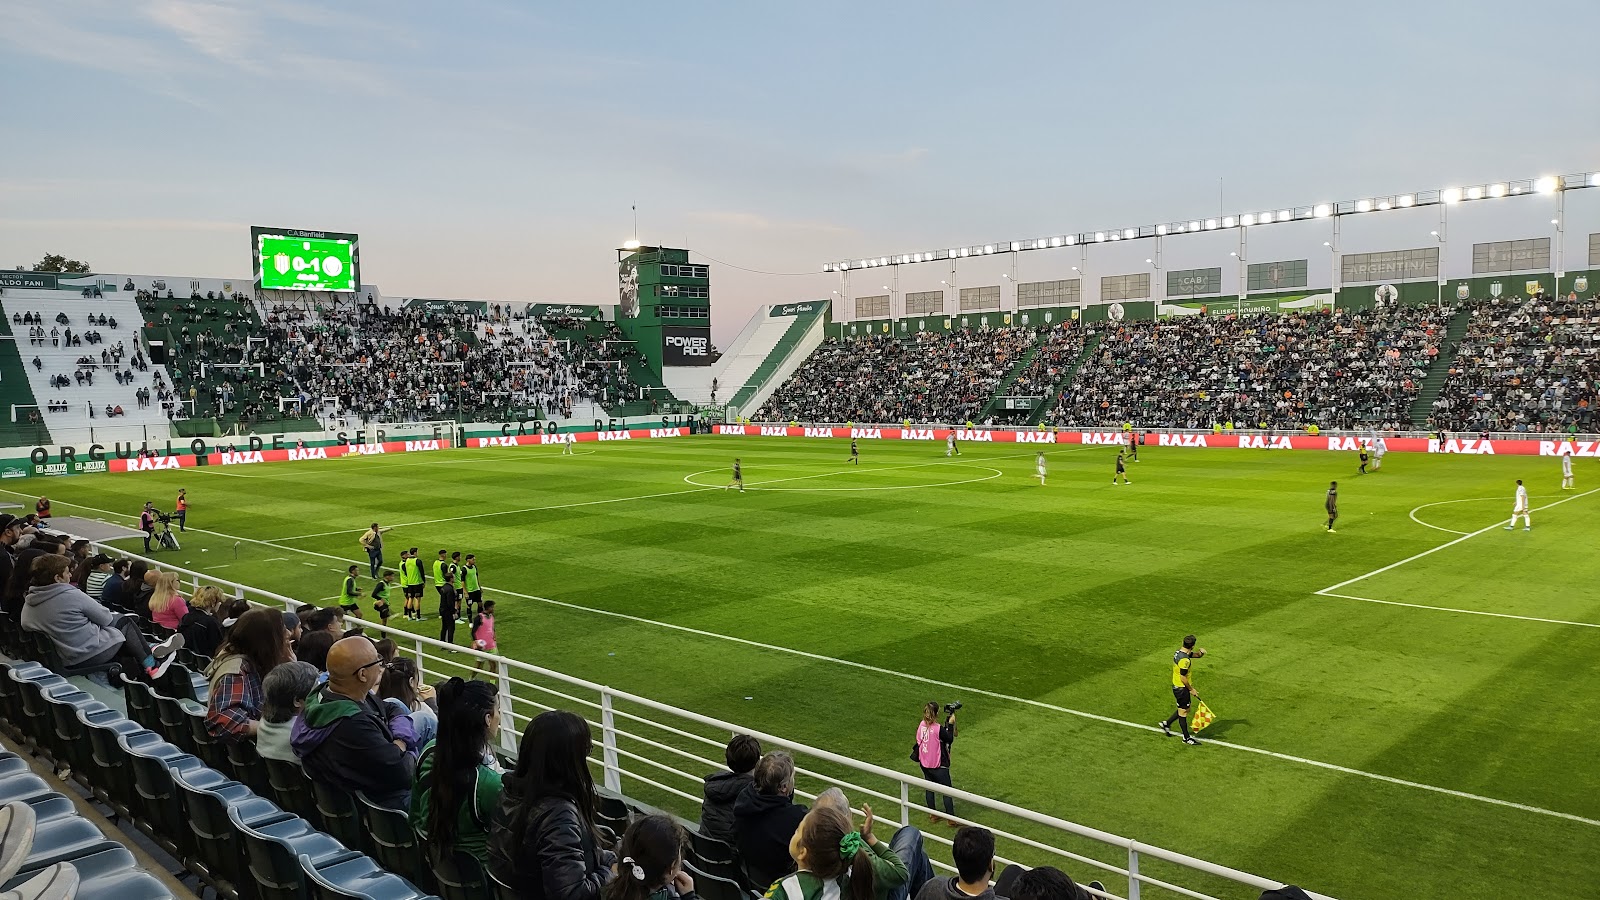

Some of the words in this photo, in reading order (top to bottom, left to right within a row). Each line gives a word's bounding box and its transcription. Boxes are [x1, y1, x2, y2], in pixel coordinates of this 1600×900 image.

[287, 230, 325, 239] C.A.Banfield
[292, 256, 320, 272] 0-1
[1183, 276, 1202, 284] CAB
[665, 336, 707, 347] POWER
[683, 346, 709, 356] ADE
[249, 434, 285, 452] DE
[337, 429, 386, 446] SER
[595, 418, 630, 432] DEL
[662, 415, 694, 428] SUR
[598, 430, 632, 441] RAZA
[650, 428, 681, 438] RAZA
[720, 425, 746, 435] RAZA
[761, 426, 788, 436] RAZA
[805, 428, 833, 438] RAZA
[850, 428, 882, 439] RAZA
[901, 429, 935, 440] RAZA
[957, 430, 992, 441] RAZA
[479, 436, 519, 448] RAZA
[541, 433, 578, 444] RAZA
[1016, 431, 1055, 443] RAZA
[1082, 432, 1124, 445] RAZA
[1159, 433, 1207, 447] RAZA
[1239, 435, 1293, 449] RAZA
[406, 439, 440, 452] RAZA
[1428, 439, 1495, 454] RAZA
[222, 450, 265, 465] RAZA
[288, 447, 328, 461] RAZA
[127, 455, 181, 471] RAZA
